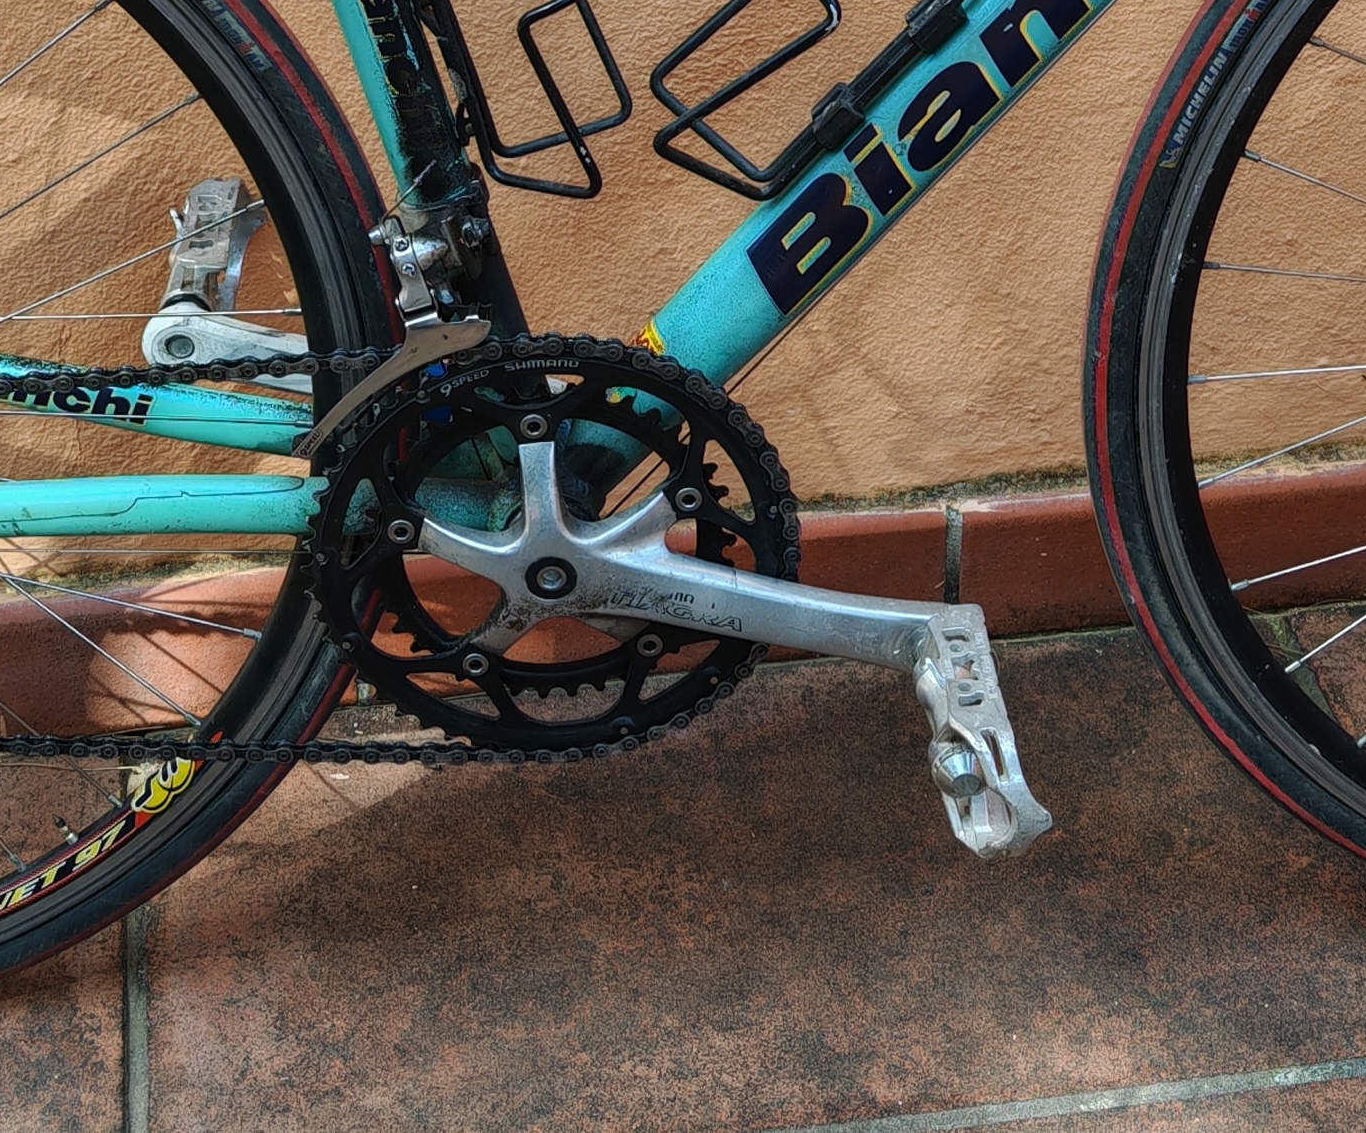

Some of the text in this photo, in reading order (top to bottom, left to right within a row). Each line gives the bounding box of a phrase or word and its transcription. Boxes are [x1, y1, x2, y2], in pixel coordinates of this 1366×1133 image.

[1172, 51, 1229, 146] MICHELIN
[503, 359, 580, 373] SHIMANO
[73, 819, 127, 872] 97
